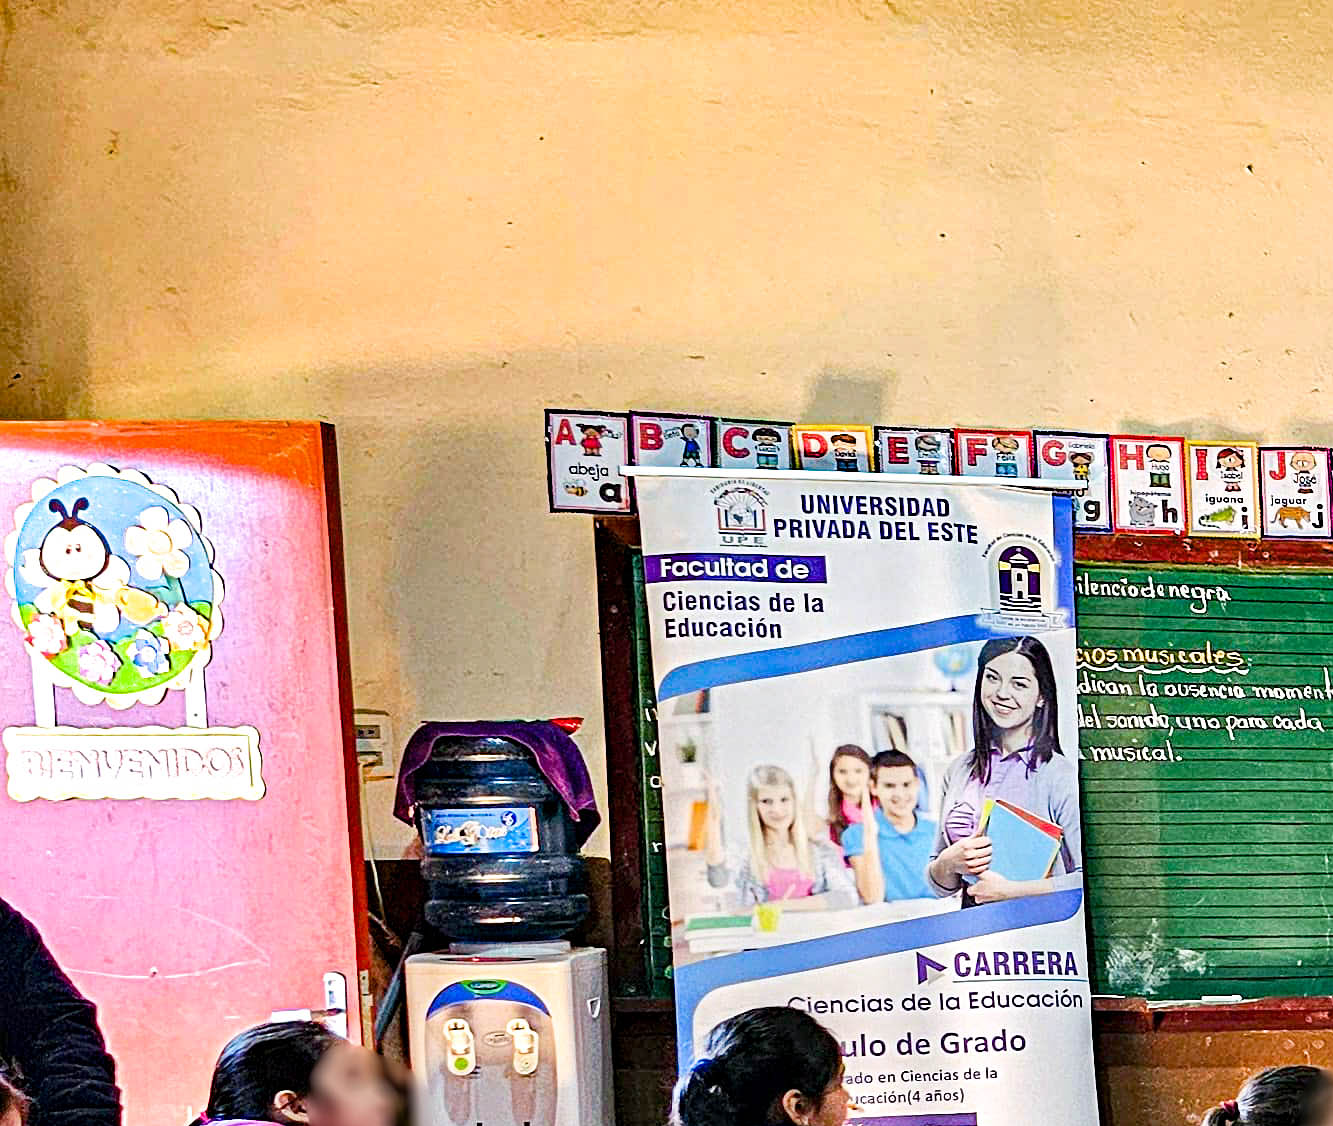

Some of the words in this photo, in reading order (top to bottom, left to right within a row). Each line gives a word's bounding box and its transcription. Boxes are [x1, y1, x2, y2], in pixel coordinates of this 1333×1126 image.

[555, 419, 576, 446] A
[640, 423, 664, 451] B
[723, 426, 750, 458] C
[803, 434, 828, 458] D
[888, 437, 909, 464] E
[966, 439, 987, 466] F
[1042, 440, 1065, 465] G
[1119, 444, 1145, 470] H
[569, 463, 609, 482] abeja
[1195, 449, 1207, 480] I
[1269, 452, 1286, 480] J
[599, 486, 622, 503] a
[801, 494, 950, 518] UNIVERSIDAD
[1205, 493, 1244, 506] iguana
[1270, 496, 1307, 508] jaguar
[1084, 498, 1101, 523] g
[1161, 500, 1178, 523] h
[773, 518, 871, 541] PRIVADA
[880, 520, 922, 541] DEL
[928, 522, 978, 544] ESTE
[660, 557, 769, 580] Facultad
[774, 560, 810, 580] de
[663, 591, 760, 612] Ciencias
[769, 592, 795, 613] de
[803, 593, 825, 613] la
[665, 616, 782, 639] Educación
[21, 746, 245, 779] BIENVENIDOS
[954, 951, 1078, 977] CARRERA
[787, 995, 893, 1015] Ciencias
[901, 994, 931, 1011] de
[939, 993, 960, 1010] la
[969, 989, 1083, 1009] Educación
[896, 1031, 930, 1055] de
[941, 1029, 1026, 1054] Grado
[878, 1073, 896, 1084] en
[900, 1069, 959, 1082] Ciencias
[964, 1068, 980, 1080] de
[985, 1067, 998, 1079] la
[925, 1088, 965, 1104] años)
